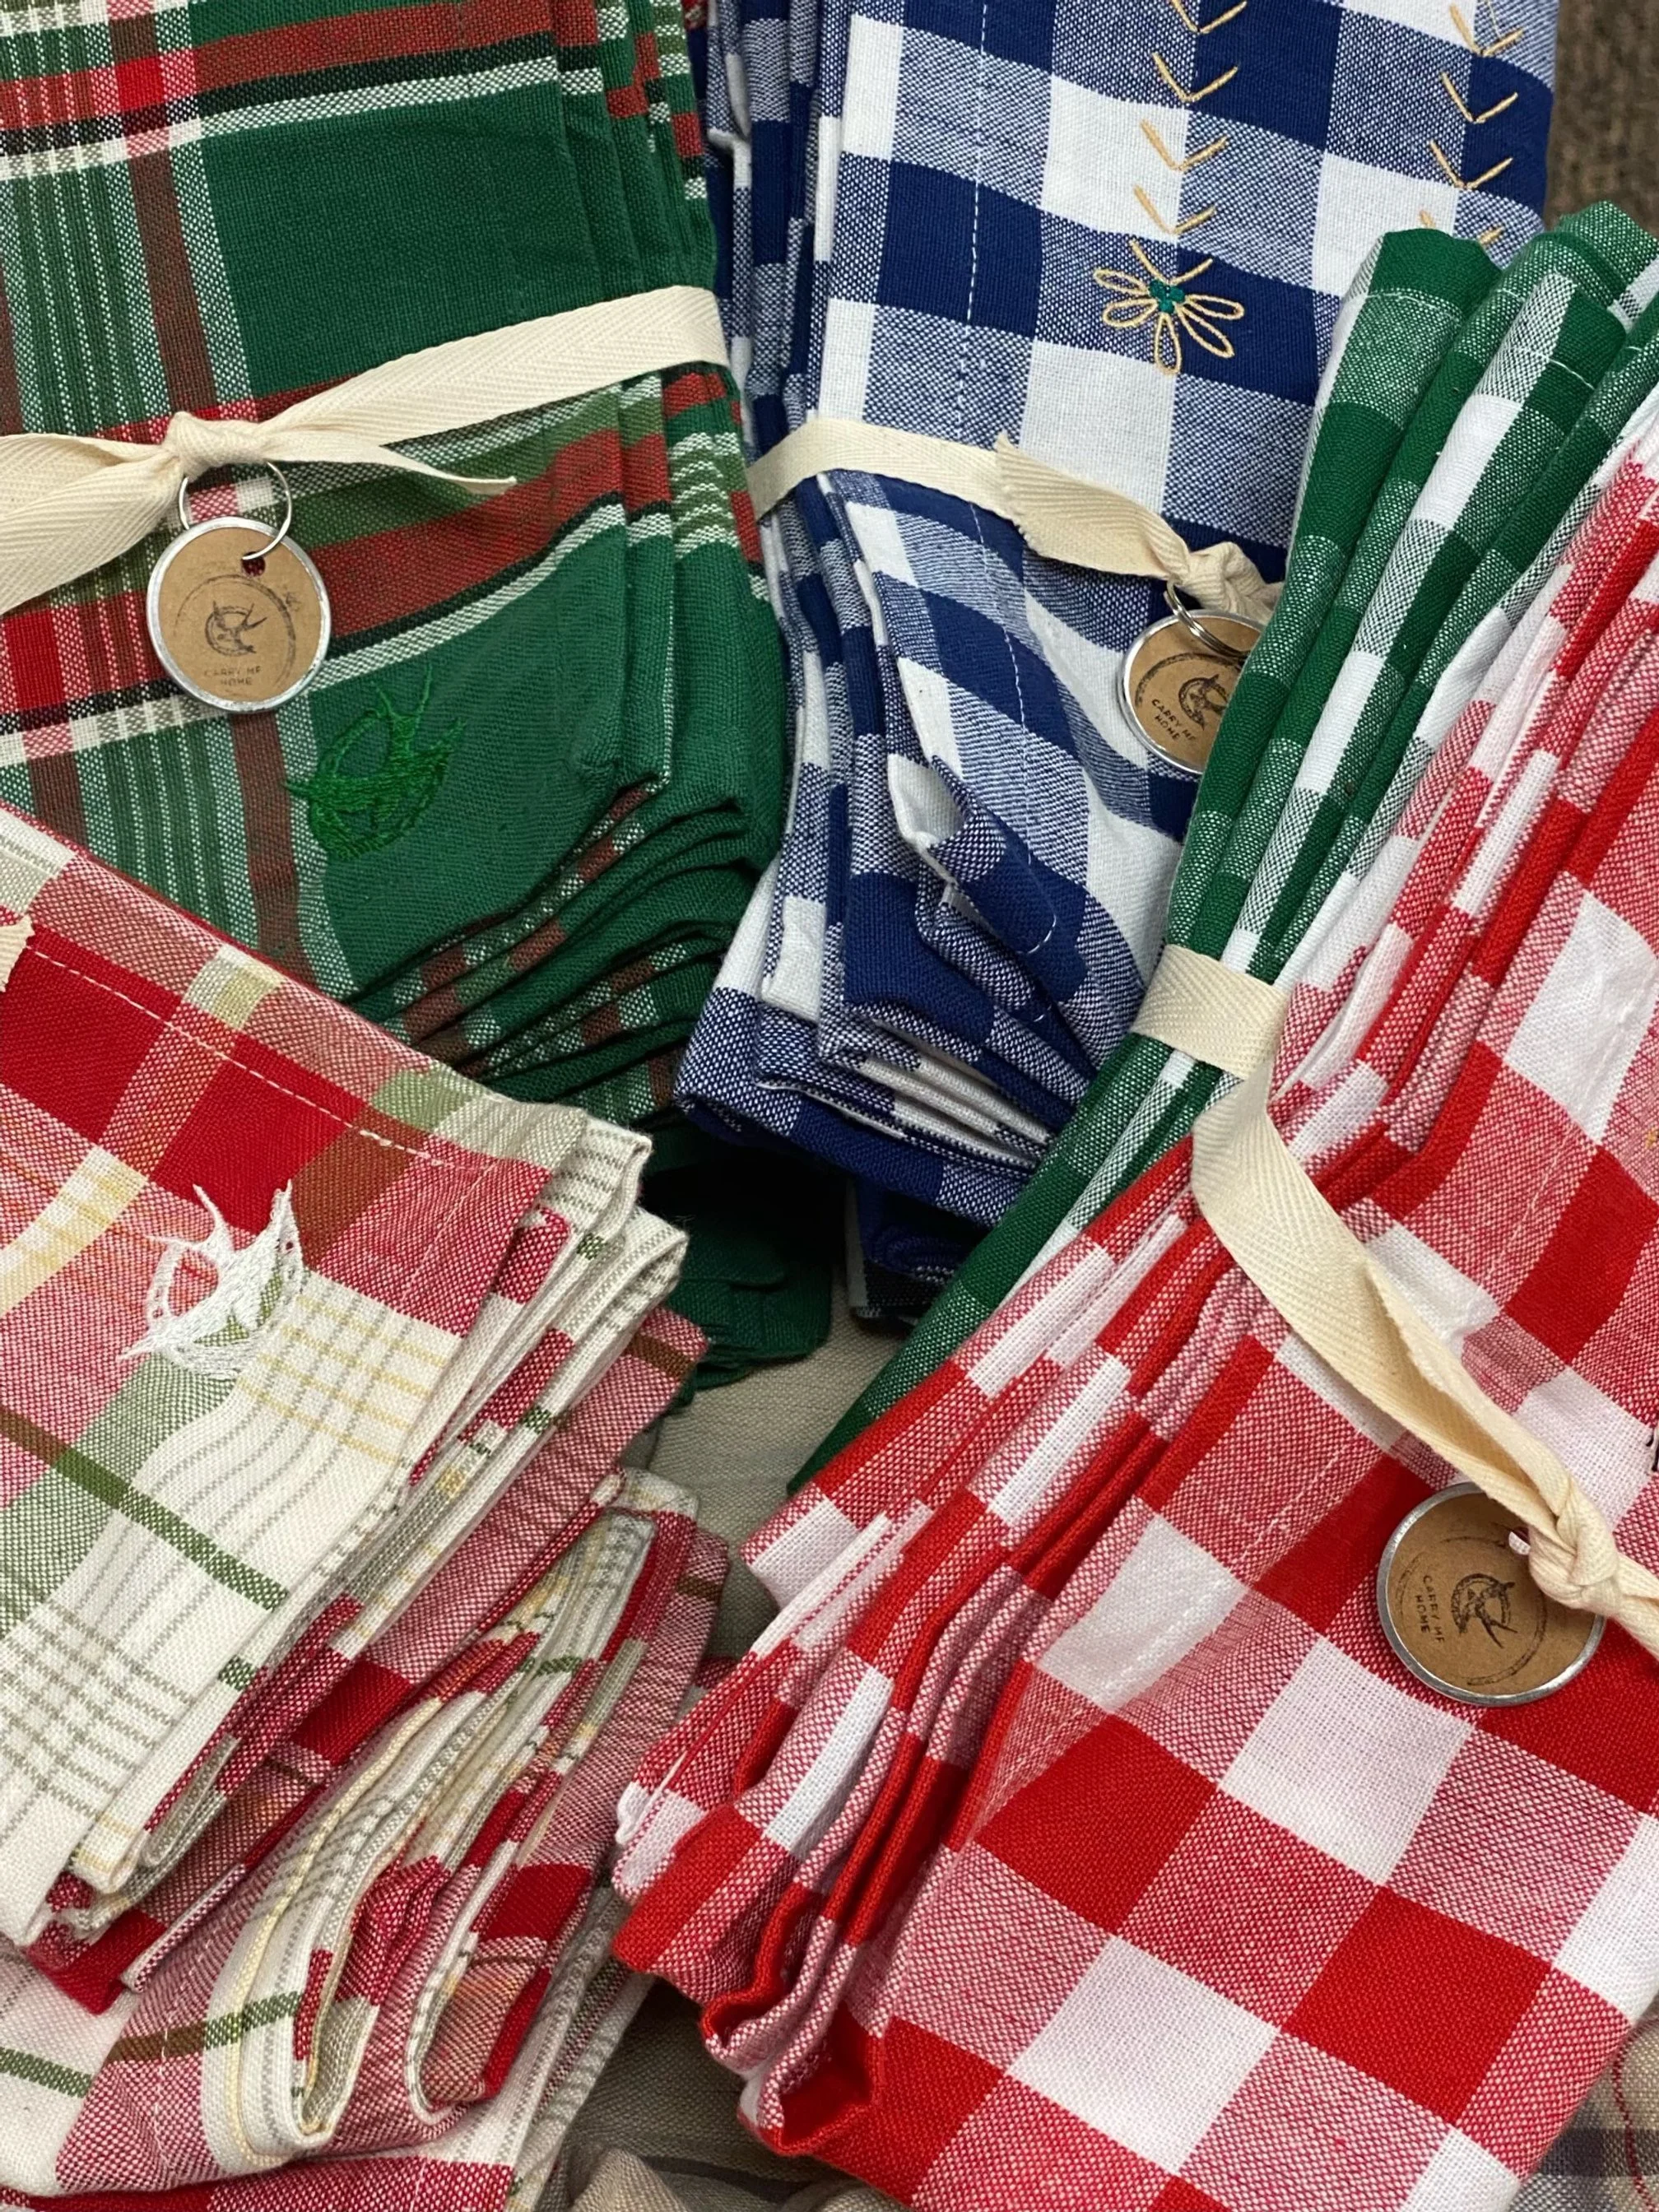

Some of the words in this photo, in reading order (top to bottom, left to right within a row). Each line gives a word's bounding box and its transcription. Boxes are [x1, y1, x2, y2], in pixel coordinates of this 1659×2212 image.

[221, 676, 253, 686] HOME
[1151, 699, 1183, 727] CARRY
[1154, 714, 1181, 740] HOME
[1415, 1595, 1431, 1633] HOME
